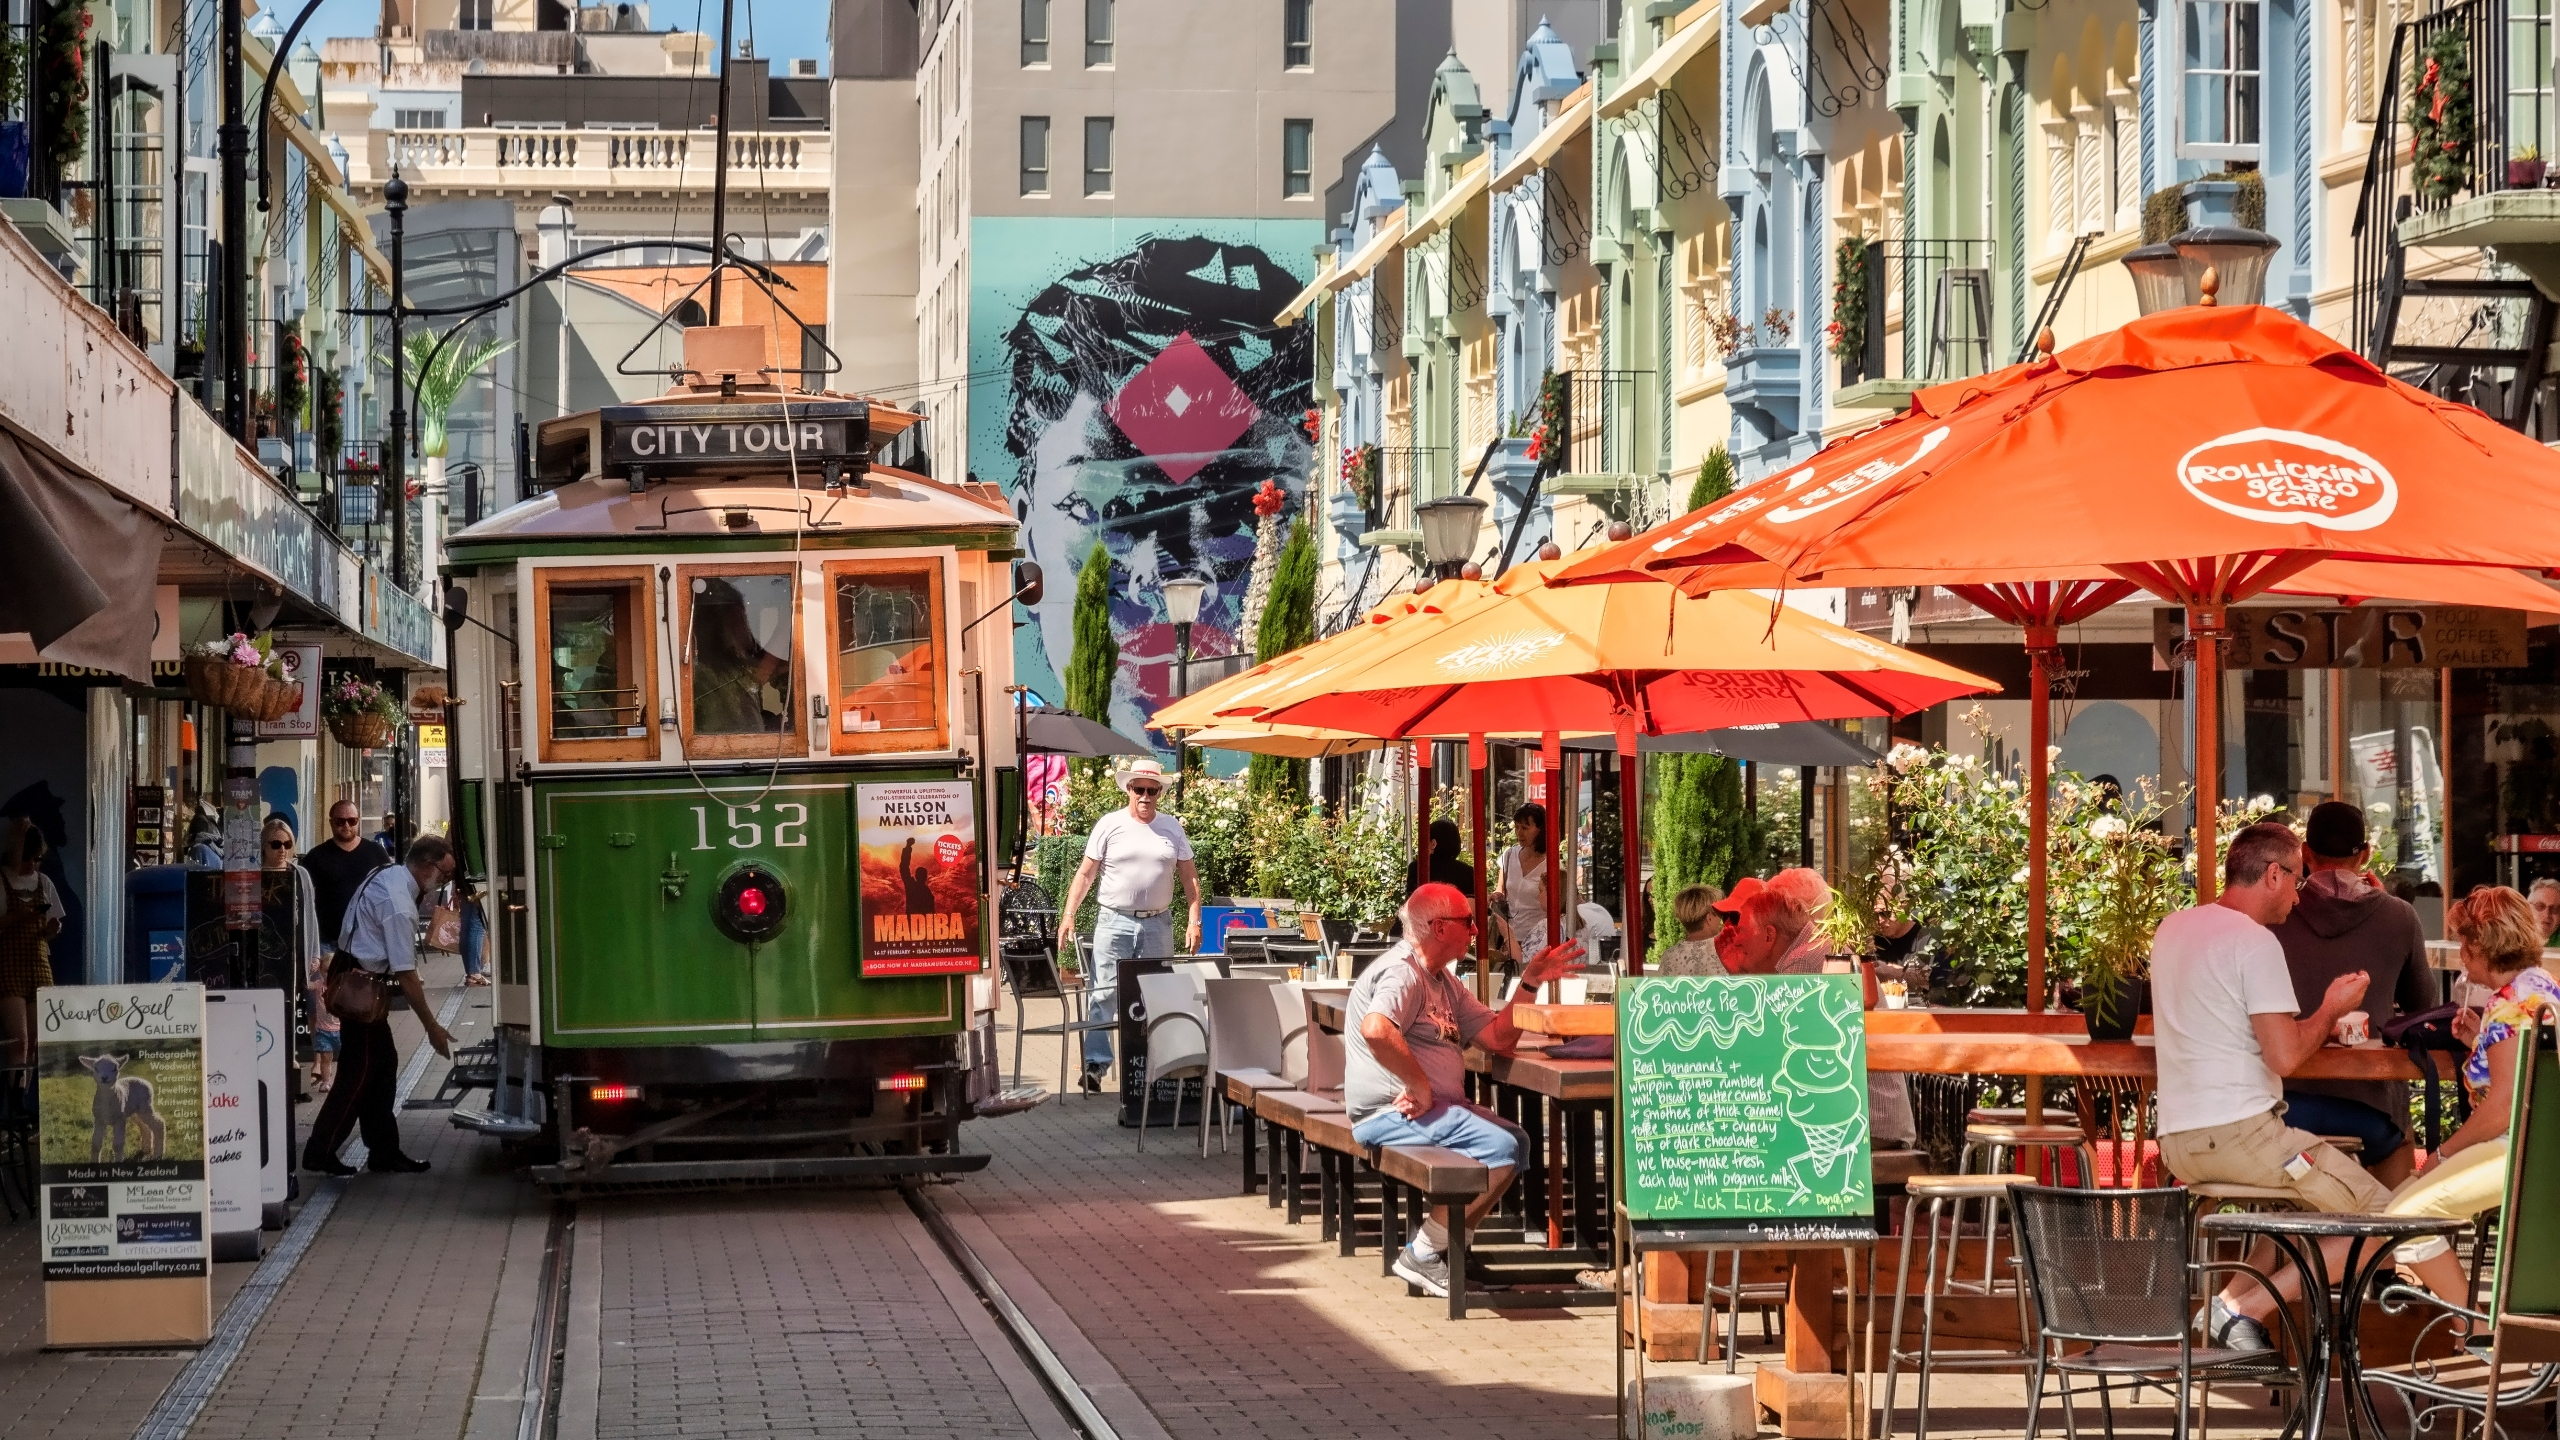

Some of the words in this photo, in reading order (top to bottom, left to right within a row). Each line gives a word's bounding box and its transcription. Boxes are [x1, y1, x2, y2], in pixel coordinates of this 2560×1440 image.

[631, 425, 713, 455] CITY
[721, 423, 824, 452] TOUR
[2434, 610, 2479, 625] FOOD
[2434, 629, 2499, 645] COFFEE
[2435, 648, 2513, 665] GALLERY
[265, 721, 288, 730] Tram
[290, 719, 312, 731] Stop
[231, 790, 253, 798] TRAM
[885, 801, 946, 814] NELSON
[689, 803, 808, 850] 152
[879, 814, 954, 827] MANDELA
[938, 841, 962, 850] TICKETS
[939, 848, 958, 856] FROM
[873, 912, 965, 942] MADIBA
[1651, 990, 1716, 1018] Banoffee
[1719, 990, 1739, 1012] Pie
[125, 993, 174, 1030] Soul
[144, 1024, 197, 1035] GALLERY
[138, 1049, 197, 1061] Photography
[150, 1061, 197, 1071] Woodwork
[1632, 1058, 1657, 1076] Real
[156, 1074, 197, 1082] Ceramics
[157, 1085, 197, 1095] Jewellery
[1678, 1077, 1713, 1095] gelato
[157, 1098, 197, 1106] Knitwear
[1632, 1093, 1653, 1107] with
[1698, 1089, 1733, 1103] butter
[173, 1108, 198, 1118] Glass
[1697, 1104, 1710, 1120] of
[1743, 1102, 1783, 1118] caramel
[176, 1120, 198, 1130] Gifts
[1733, 1120, 1777, 1142] crunchy
[184, 1132, 198, 1141] Art
[235, 1128, 247, 1141] to
[1674, 1133, 1701, 1149] dark
[1732, 1150, 1765, 1169] fresh
[68, 1168, 96, 1179] Made
[100, 1169, 108, 1177] in
[111, 1167, 133, 1177] New
[137, 1165, 178, 1177] Zealand
[1639, 1173, 1666, 1188] each
[1668, 1170, 1690, 1196] day
[1693, 1170, 1718, 1186] with
[1723, 1172, 1768, 1190] organic
[1655, 1191, 1684, 1211] Lick
[1693, 1189, 1726, 1211] Lick
[60, 1222, 113, 1236] BOWRON
[48, 1261, 201, 1275] www.heartandsoulgallery.co.nz
[1662, 1422, 1704, 1437] WOOF
